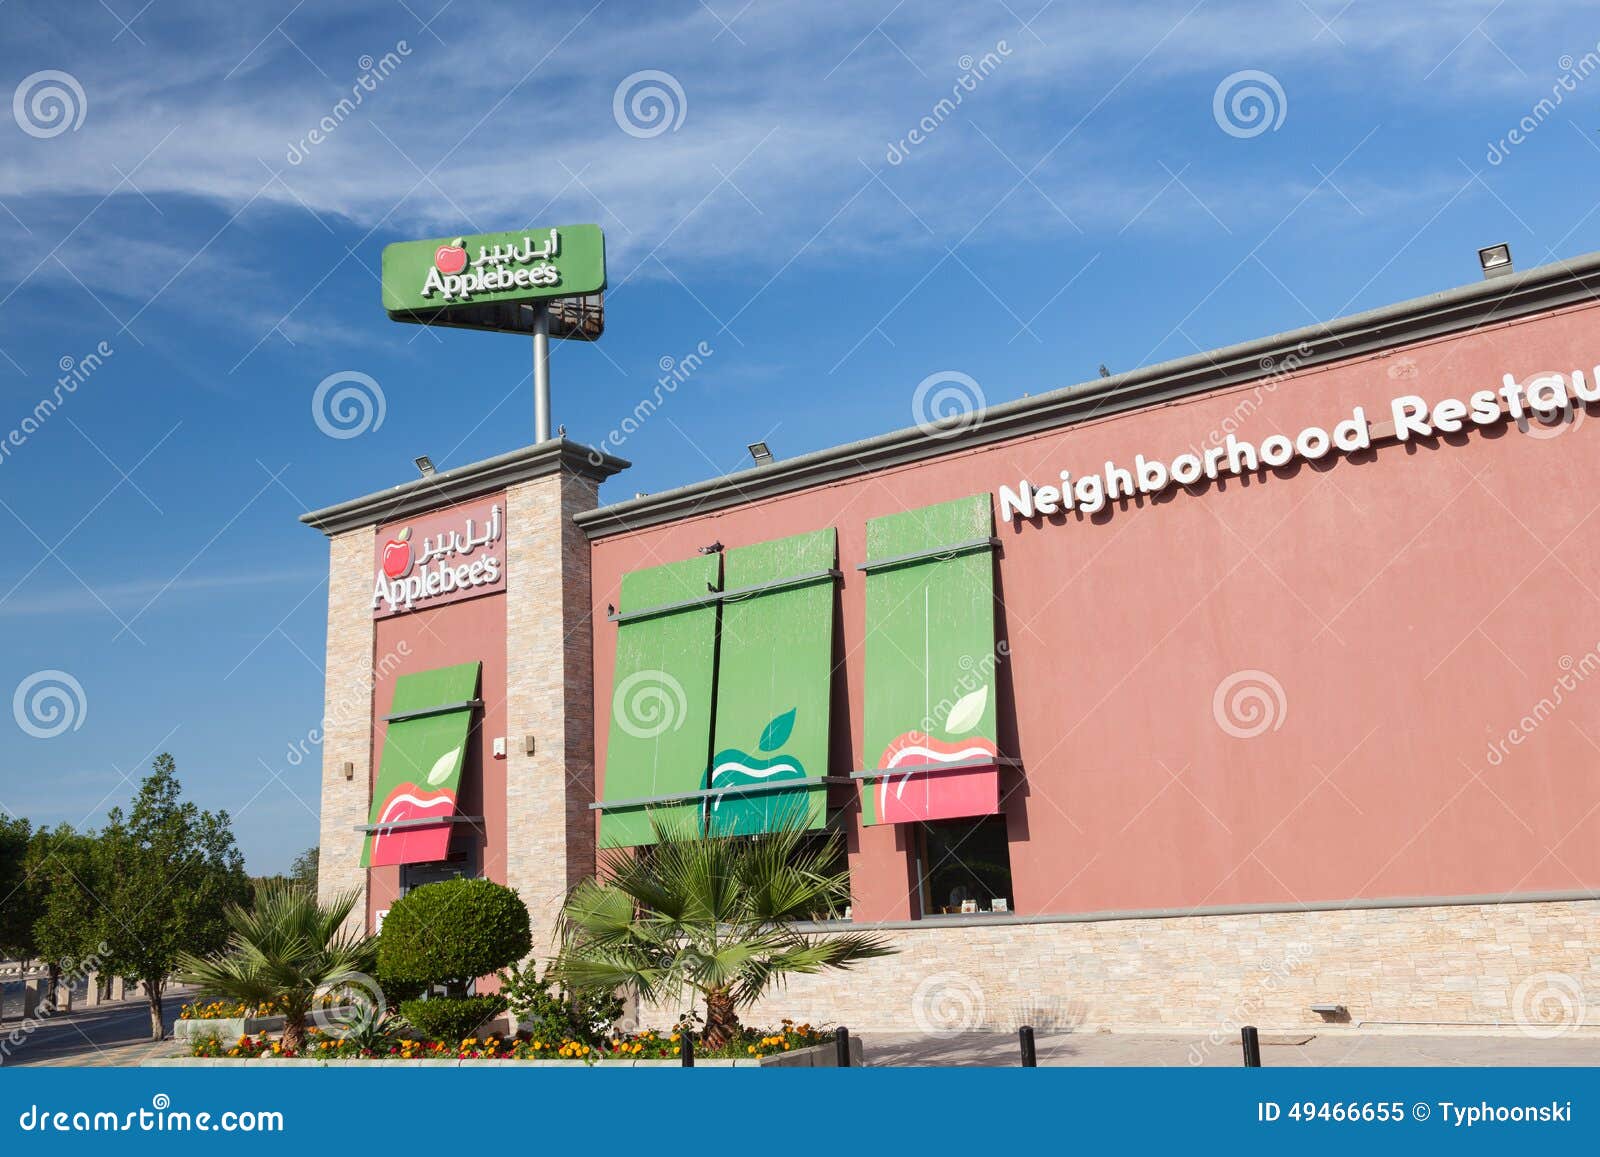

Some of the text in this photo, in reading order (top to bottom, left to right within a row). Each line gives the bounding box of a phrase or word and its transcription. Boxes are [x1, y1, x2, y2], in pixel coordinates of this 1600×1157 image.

[421, 263, 558, 299] Applebee's
[999, 364, 1600, 523] Neighborhood Restau
[371, 553, 500, 612] Applebee's
